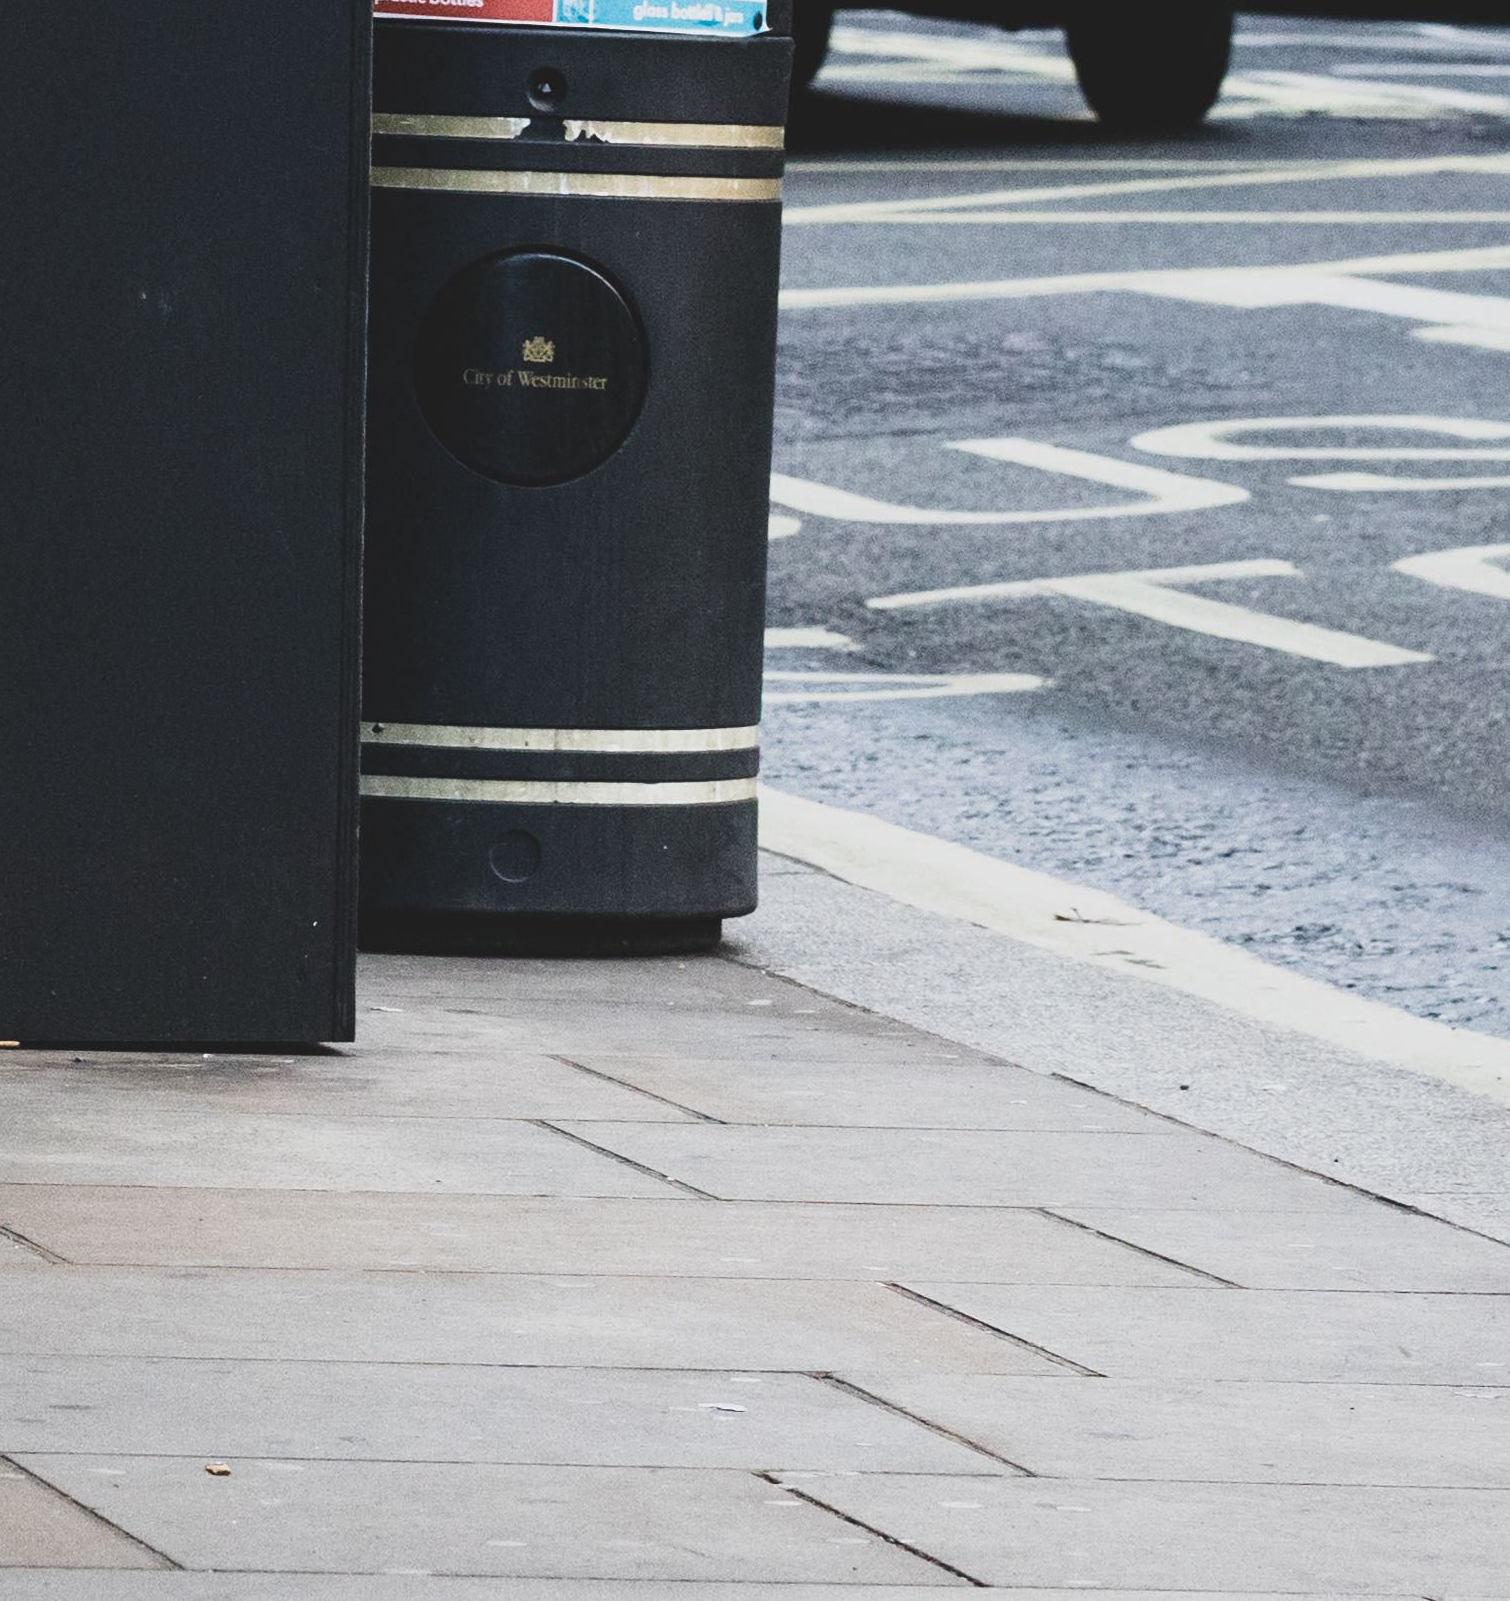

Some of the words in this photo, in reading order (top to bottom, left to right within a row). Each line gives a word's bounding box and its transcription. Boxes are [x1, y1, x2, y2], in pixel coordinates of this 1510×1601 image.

[632, 0, 669, 22] glass
[463, 368, 493, 390] City
[497, 369, 514, 387] of
[517, 371, 608, 390] Westminster
